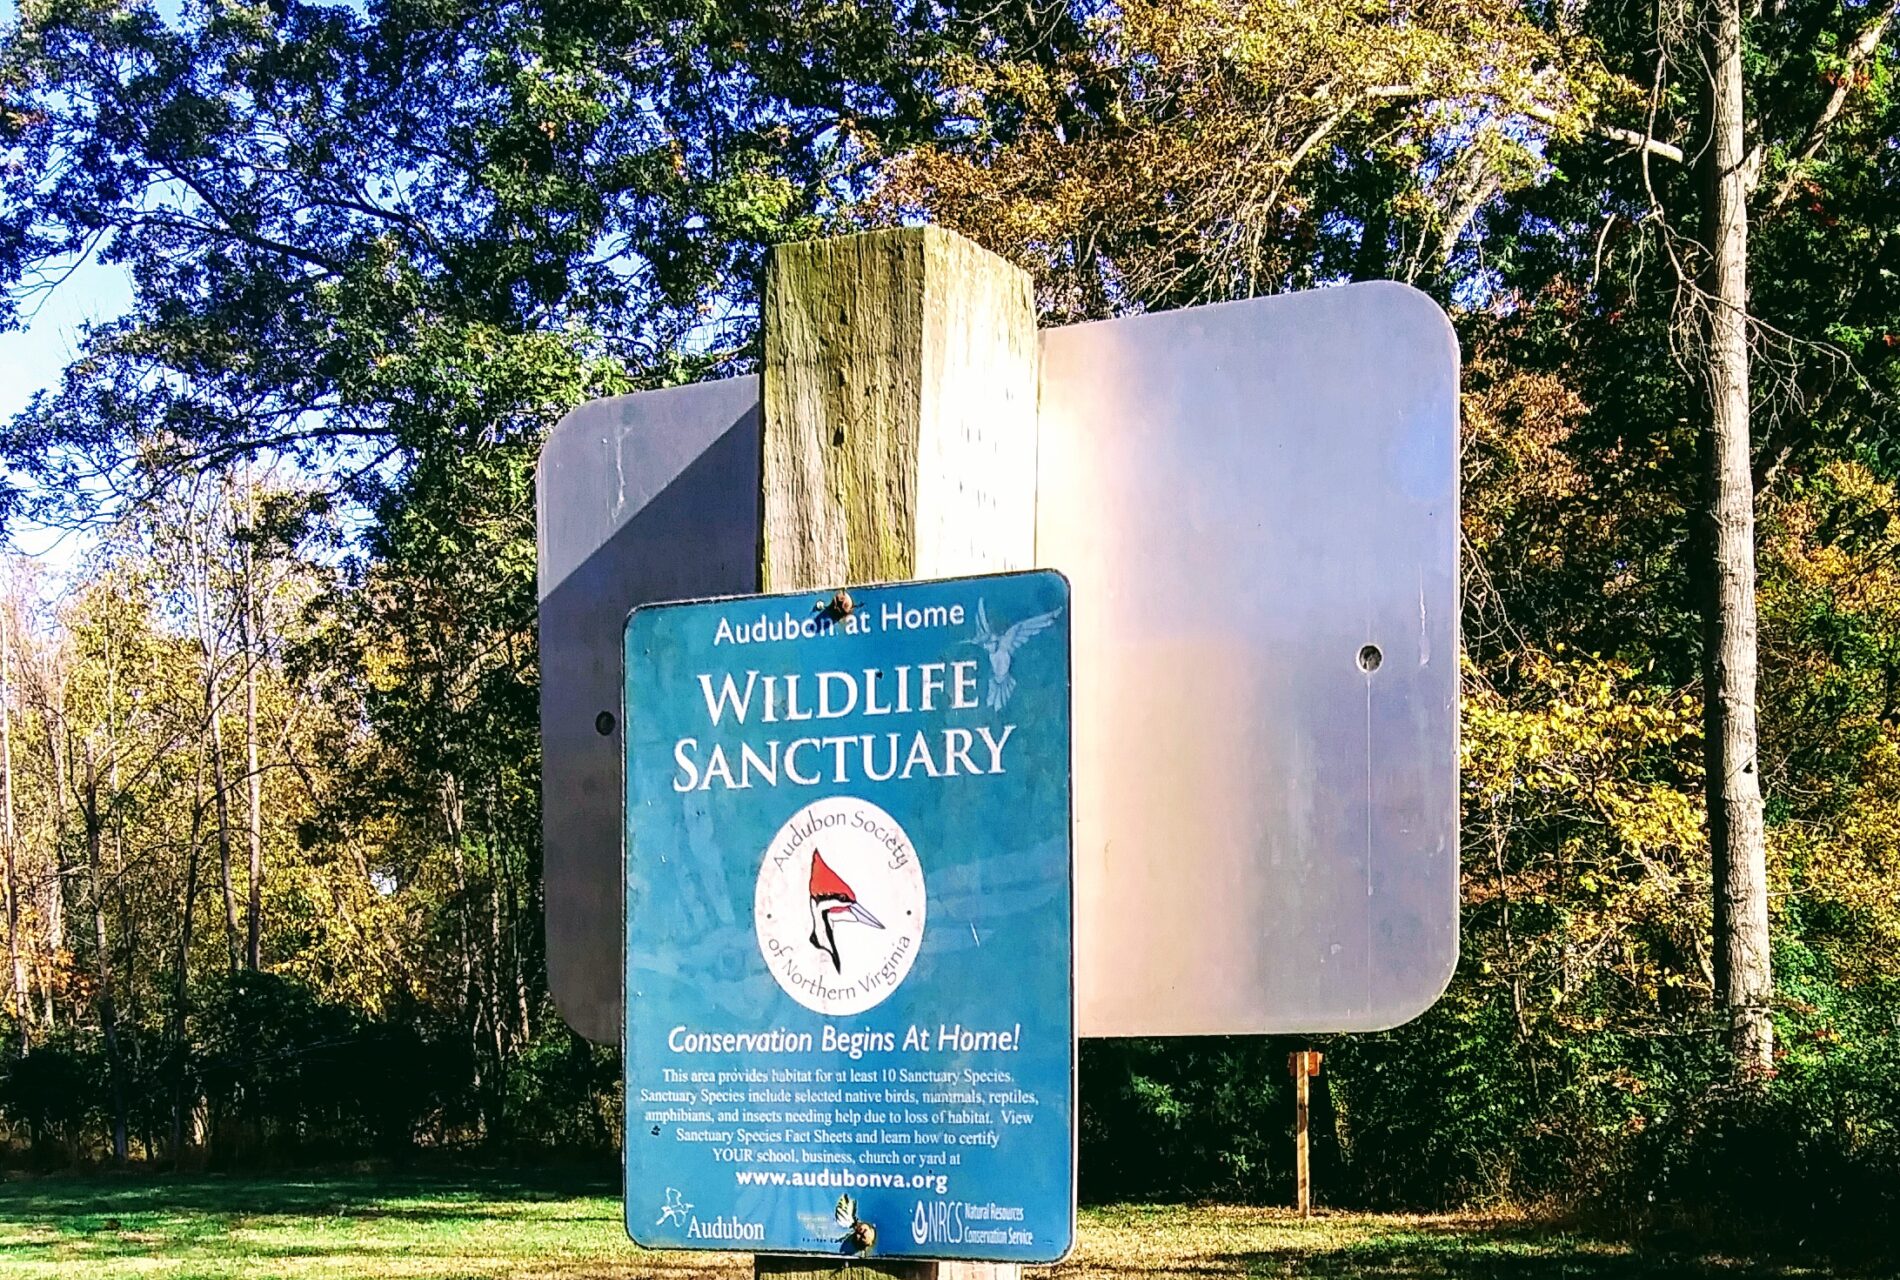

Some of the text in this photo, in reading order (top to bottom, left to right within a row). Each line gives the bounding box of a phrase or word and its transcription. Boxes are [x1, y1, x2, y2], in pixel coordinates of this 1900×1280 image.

[714, 602, 965, 646] Audubon at Home
[697, 661, 979, 727] WILDLIFE
[673, 725, 1016, 793] SANCTUARY
[774, 810, 908, 872] Audubon Society
[768, 936, 910, 1001] of Northern Virginia
[668, 1023, 1021, 1060] Conservation Begins At Home!
[662, 1068, 1016, 1086] This area provides habitat for at least 10 Sanctuary Species.
[640, 1088, 1040, 1107] Sanctuary Species include selected native birds, mammals, reptiles,
[645, 1108, 1034, 1126] amphibians, and insects needing help due to loss of habitat. View
[676, 1128, 1000, 1148] Sanctuary Species Fact Sheets and learn how to certify
[713, 1148, 753, 1163] YOUR
[802, 1149, 856, 1166] business,
[858, 1150, 900, 1165] church
[903, 1154, 915, 1165] or
[919, 1151, 946, 1168] yard
[949, 1152, 960, 1165] at
[736, 1167, 948, 1194] www.audubonva.org
[928, 1201, 963, 1244] NRCS
[965, 1202, 1025, 1222] Natural Resources
[687, 1215, 764, 1241] Audubon
[964, 1226, 1033, 1246] Conservation Service
